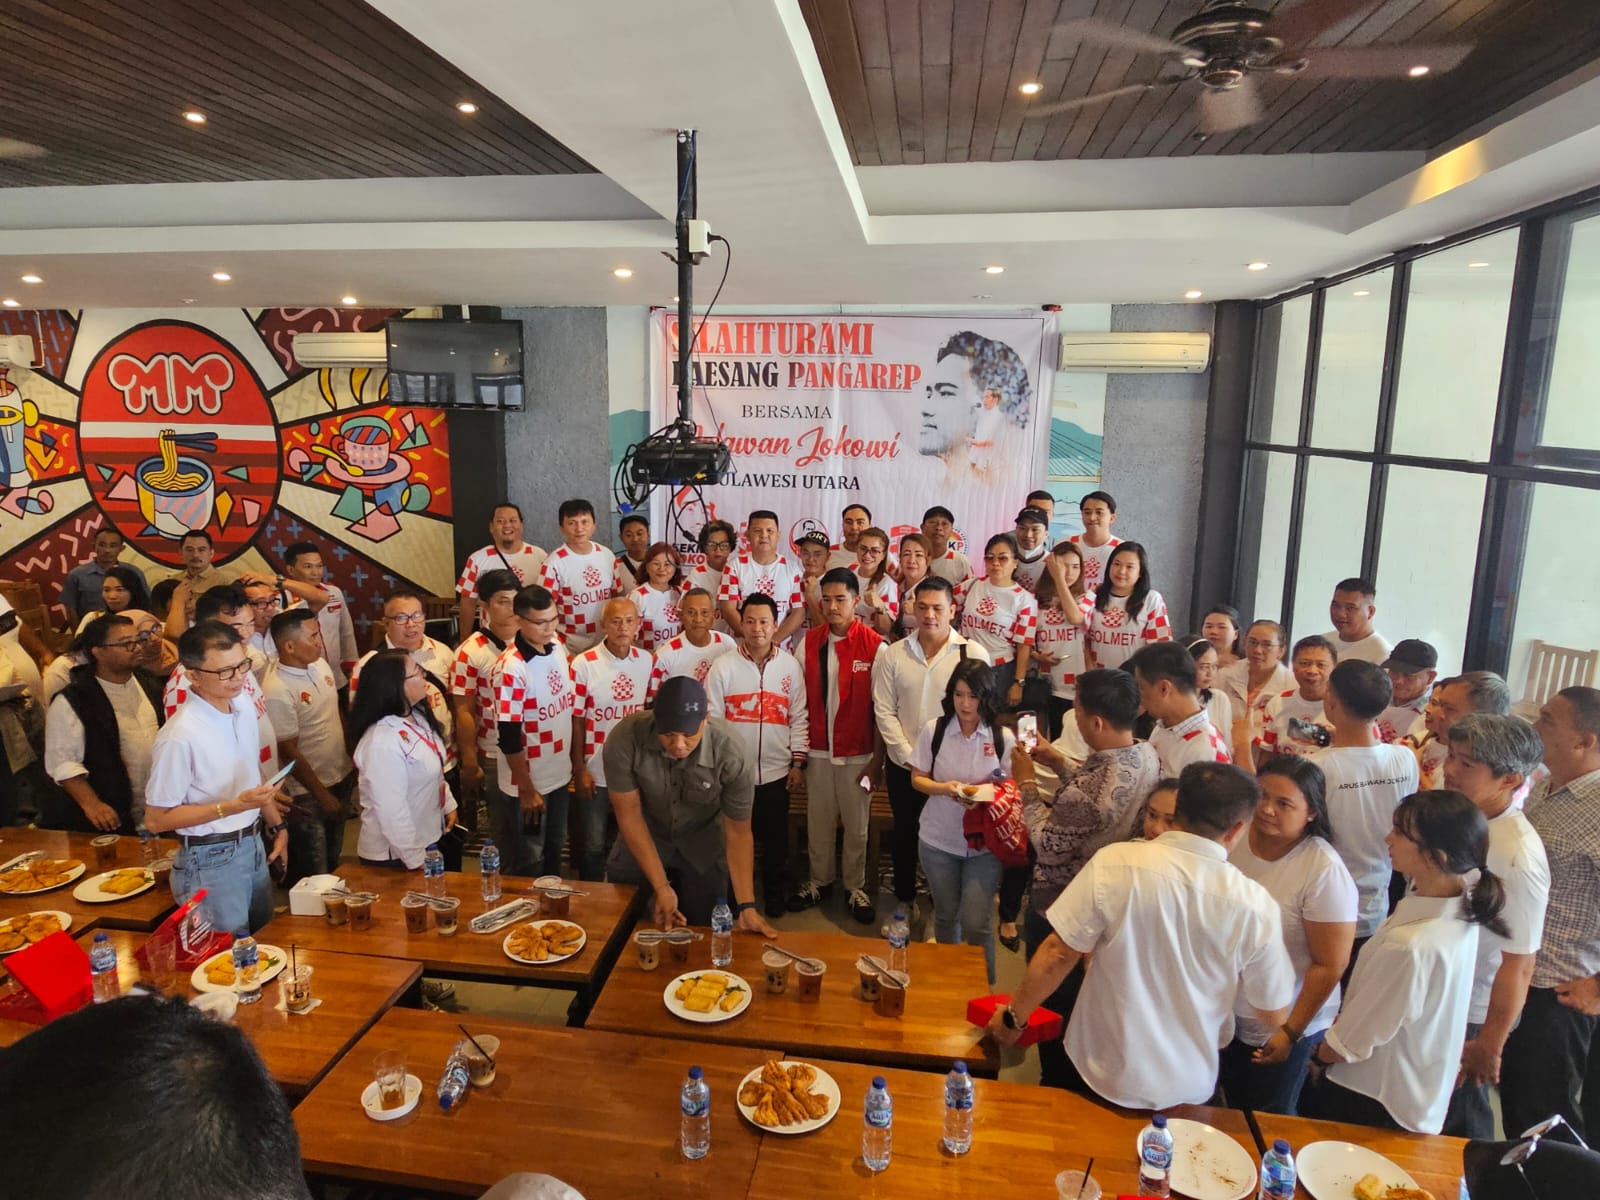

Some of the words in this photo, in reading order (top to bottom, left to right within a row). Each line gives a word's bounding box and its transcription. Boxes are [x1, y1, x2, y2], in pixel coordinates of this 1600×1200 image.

[787, 361, 922, 390] PANGAREP
[741, 404, 832, 420] BERSAMA
[795, 423, 901, 468] Jokowi
[719, 472, 798, 489] ULAWESI
[802, 474, 861, 490] UTARA
[572, 588, 611, 607] SOLME
[538, 691, 575, 721] SOLME
[594, 703, 645, 722] SOLME
